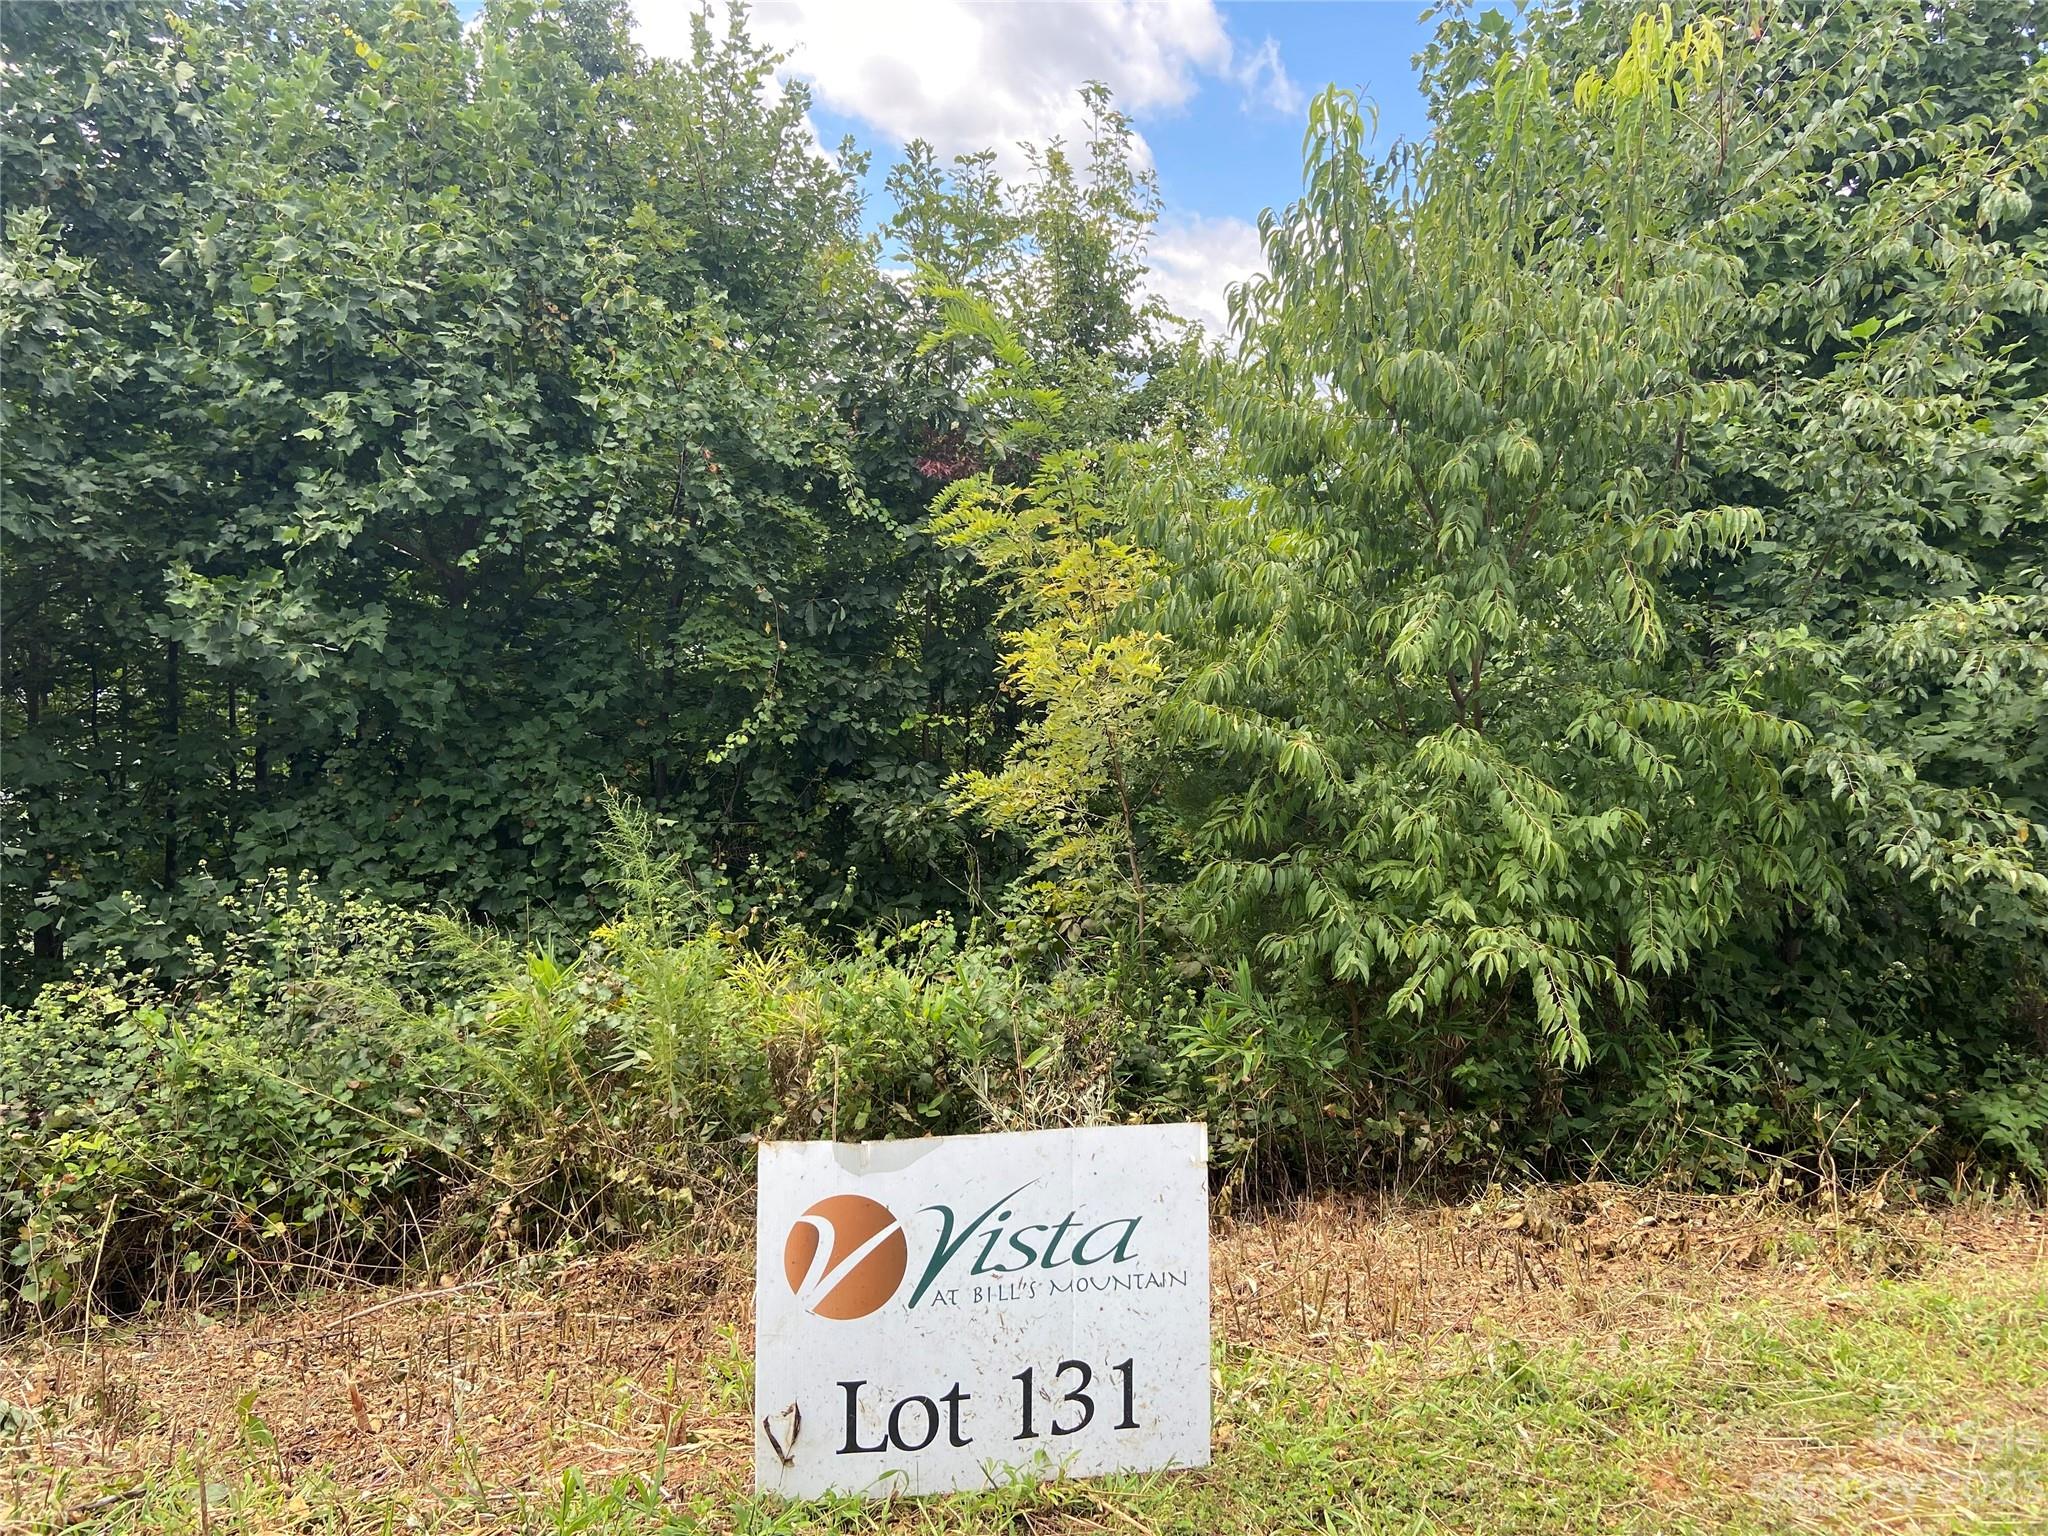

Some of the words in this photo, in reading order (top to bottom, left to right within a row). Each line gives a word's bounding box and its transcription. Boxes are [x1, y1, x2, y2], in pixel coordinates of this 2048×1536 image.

[908, 1177, 1142, 1309] Vista
[931, 1288, 959, 1307] AT
[973, 1283, 1037, 1304] BILL'S
[1050, 1270, 1188, 1294] MOUNTAIN
[836, 1380, 973, 1455] Lot
[1012, 1357, 1141, 1441] 131
